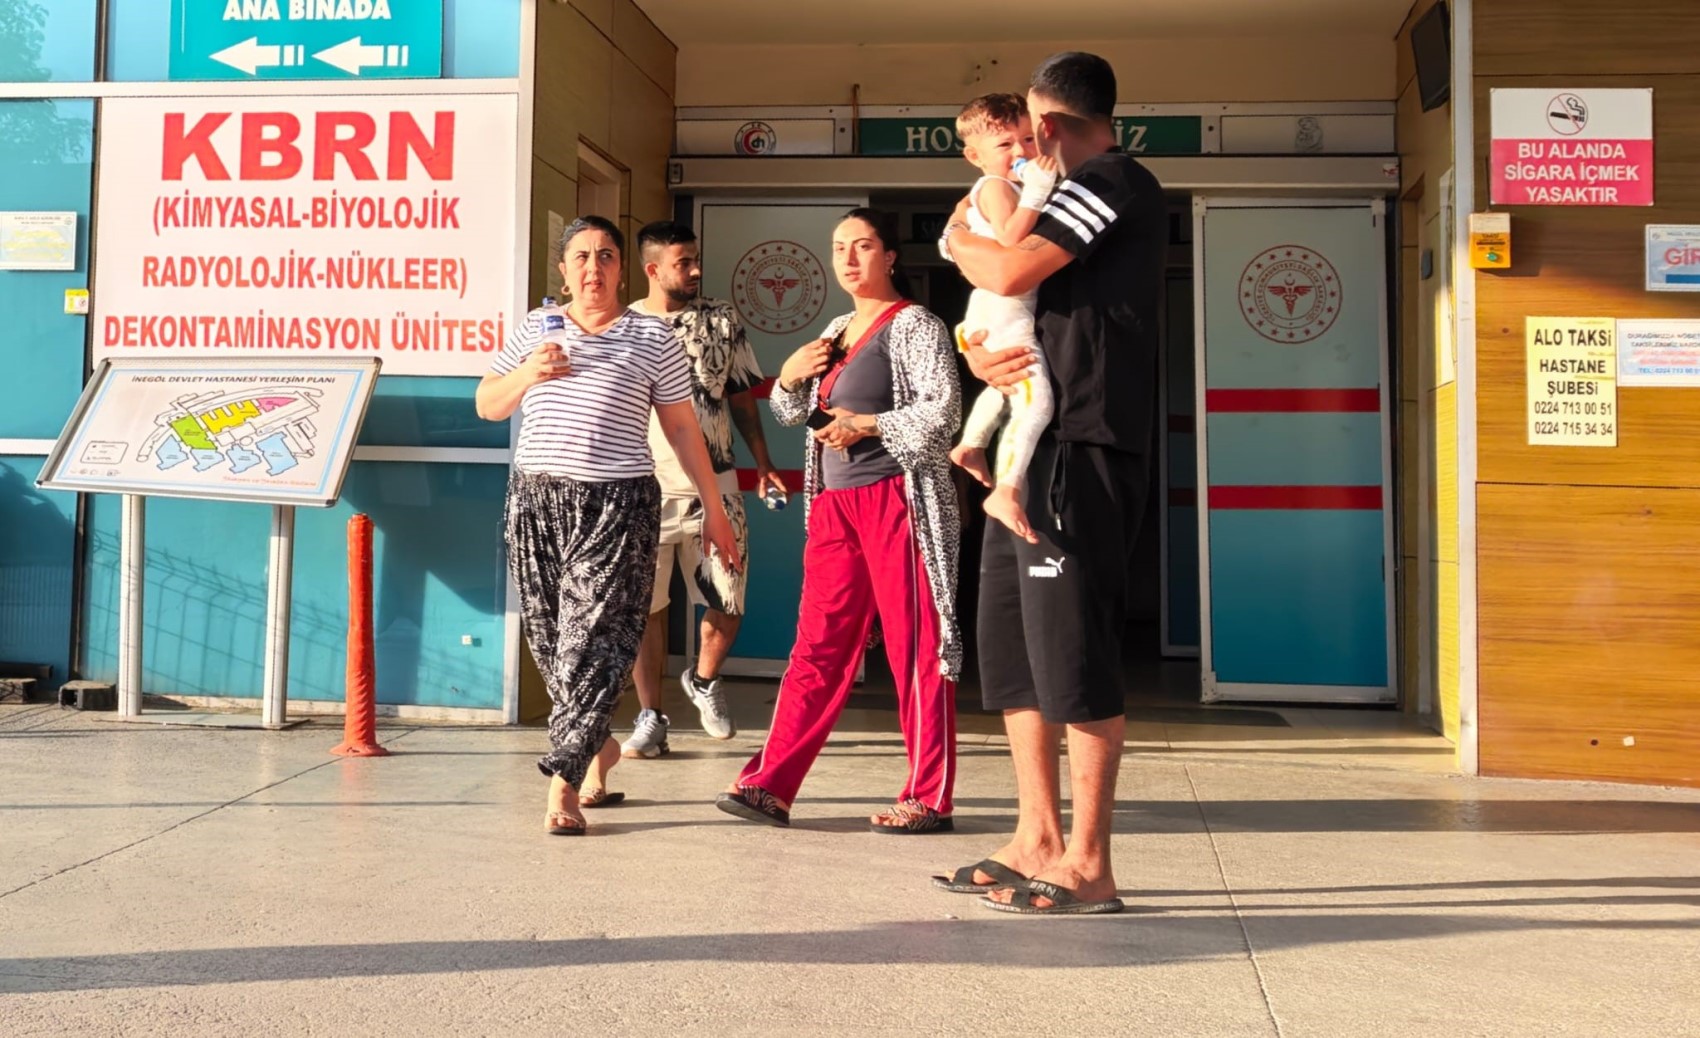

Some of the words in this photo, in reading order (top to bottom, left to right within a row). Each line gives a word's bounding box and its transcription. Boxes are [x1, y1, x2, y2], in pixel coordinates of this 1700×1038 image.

[222, 0, 281, 20] ANA
[161, 111, 455, 181] KBRN
[906, 126, 963, 152] HO
[1518, 143, 1543, 159] BU
[1548, 143, 1626, 159] ALANDA
[1504, 162, 1575, 180] SİGARA
[1580, 162, 1639, 184] İÇMEK
[1526, 187, 1618, 202] YASAKTIR
[153, 189, 460, 236] (KİMYASAL-BİYOLOJİK
[143, 249, 468, 299] RADYOLOJİK-NÜKLEER)
[104, 309, 380, 350] DEKONTAMİNASYON
[391, 310, 505, 352] ÜNİTESİ
[1534, 329, 1563, 346] ALO
[1539, 360, 1606, 373] HASTANE
[131, 375, 167, 383] İNEGÖL
[205, 375, 258, 383] HASTANESİ
[259, 375, 305, 384] YERLEŞİM
[307, 376, 336, 384] PLANI
[1535, 401, 1559, 414] 0224
[1563, 402, 1580, 415] 713
[1585, 402, 1597, 415] 00
[1600, 403, 1612, 415] 51
[1535, 422, 1559, 434] 0224
[1563, 422, 1581, 435] 715
[1585, 422, 1597, 435] 34
[1601, 422, 1613, 435] 34
